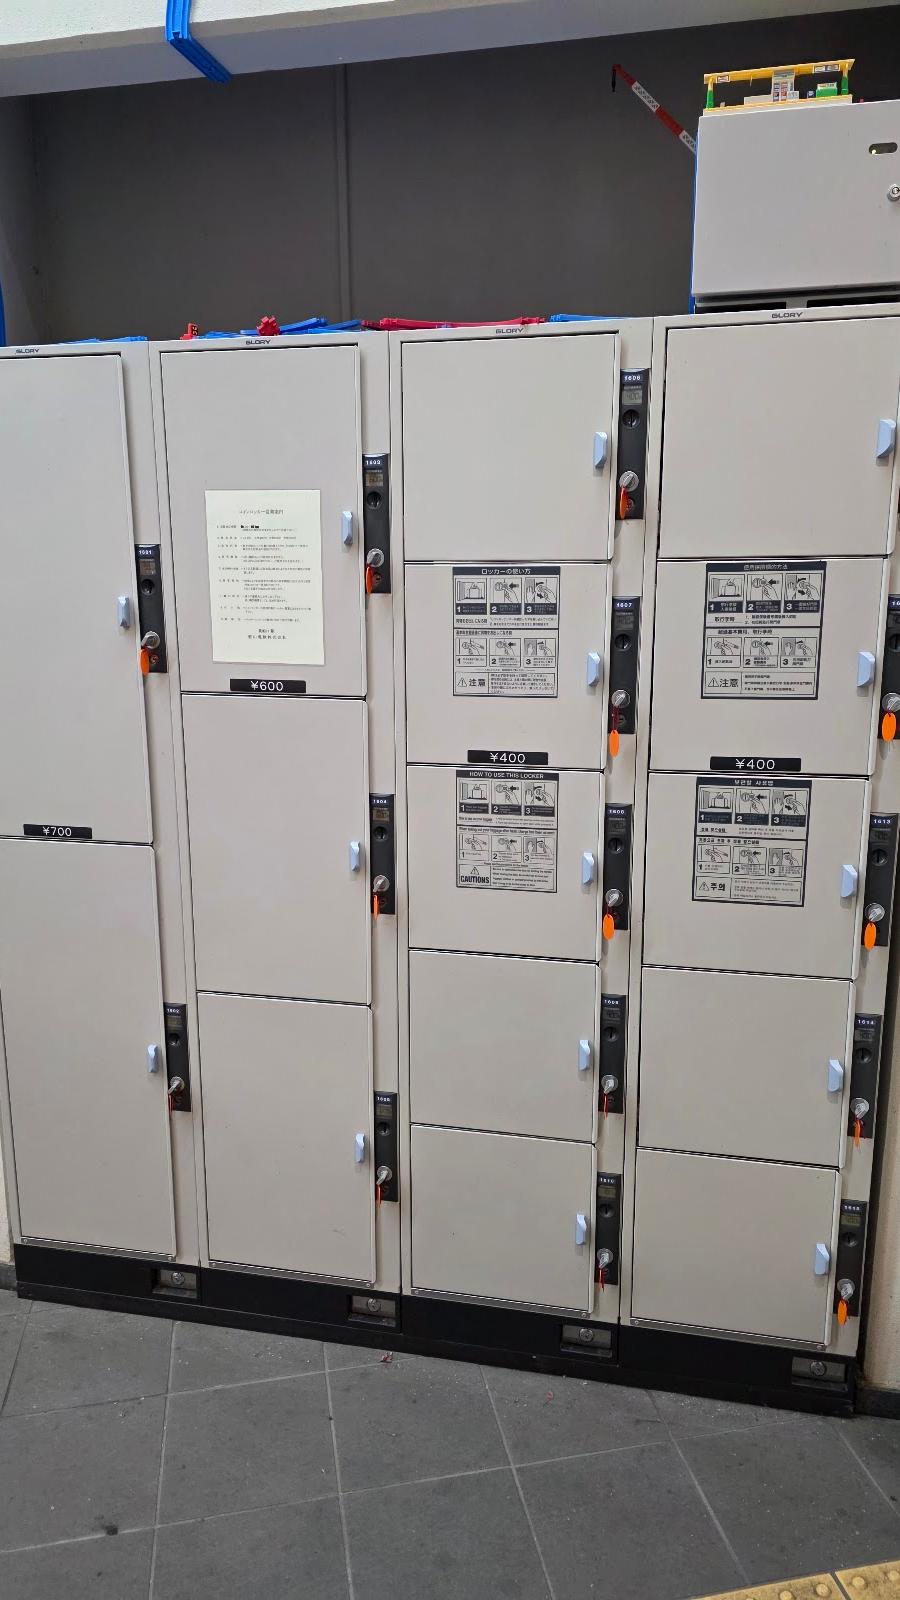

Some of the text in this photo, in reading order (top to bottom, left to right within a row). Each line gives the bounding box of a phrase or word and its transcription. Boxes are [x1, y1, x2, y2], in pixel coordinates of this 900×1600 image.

[250, 680, 284, 691] ¥600
[719, 679, 739, 688] 注意
[490, 752, 526, 763] ¥400
[735, 759, 775, 770] ¥400
[773, 816, 780, 824] 3
[42, 826, 72, 837] ¥700
[734, 865, 740, 873] 2
[460, 875, 490, 884] CAUTIONS
[710, 883, 726, 892] 주의
